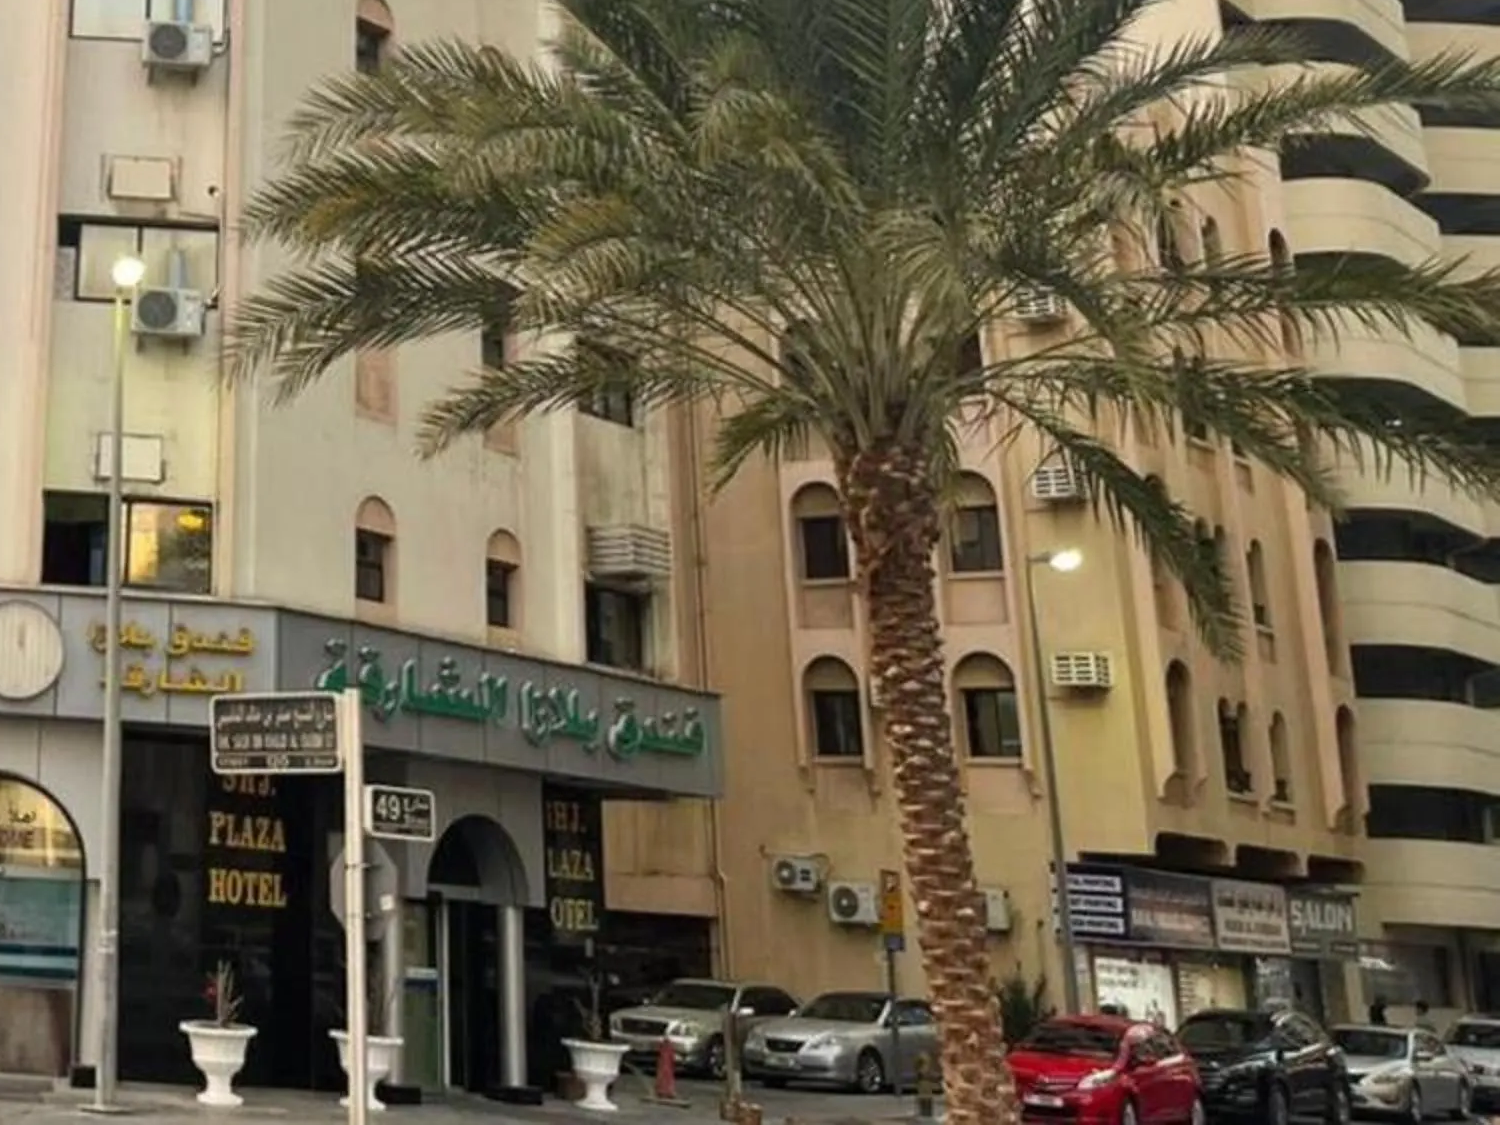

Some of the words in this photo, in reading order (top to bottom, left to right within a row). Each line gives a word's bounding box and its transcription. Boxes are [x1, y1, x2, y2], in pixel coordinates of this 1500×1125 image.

[166, 623, 255, 657] فندق
[606, 695, 707, 760] فندق
[376, 794, 401, 821] 49
[208, 810, 286, 852] PLAZA
[208, 868, 288, 908] HOTEL
[1290, 899, 1354, 935] SALON
